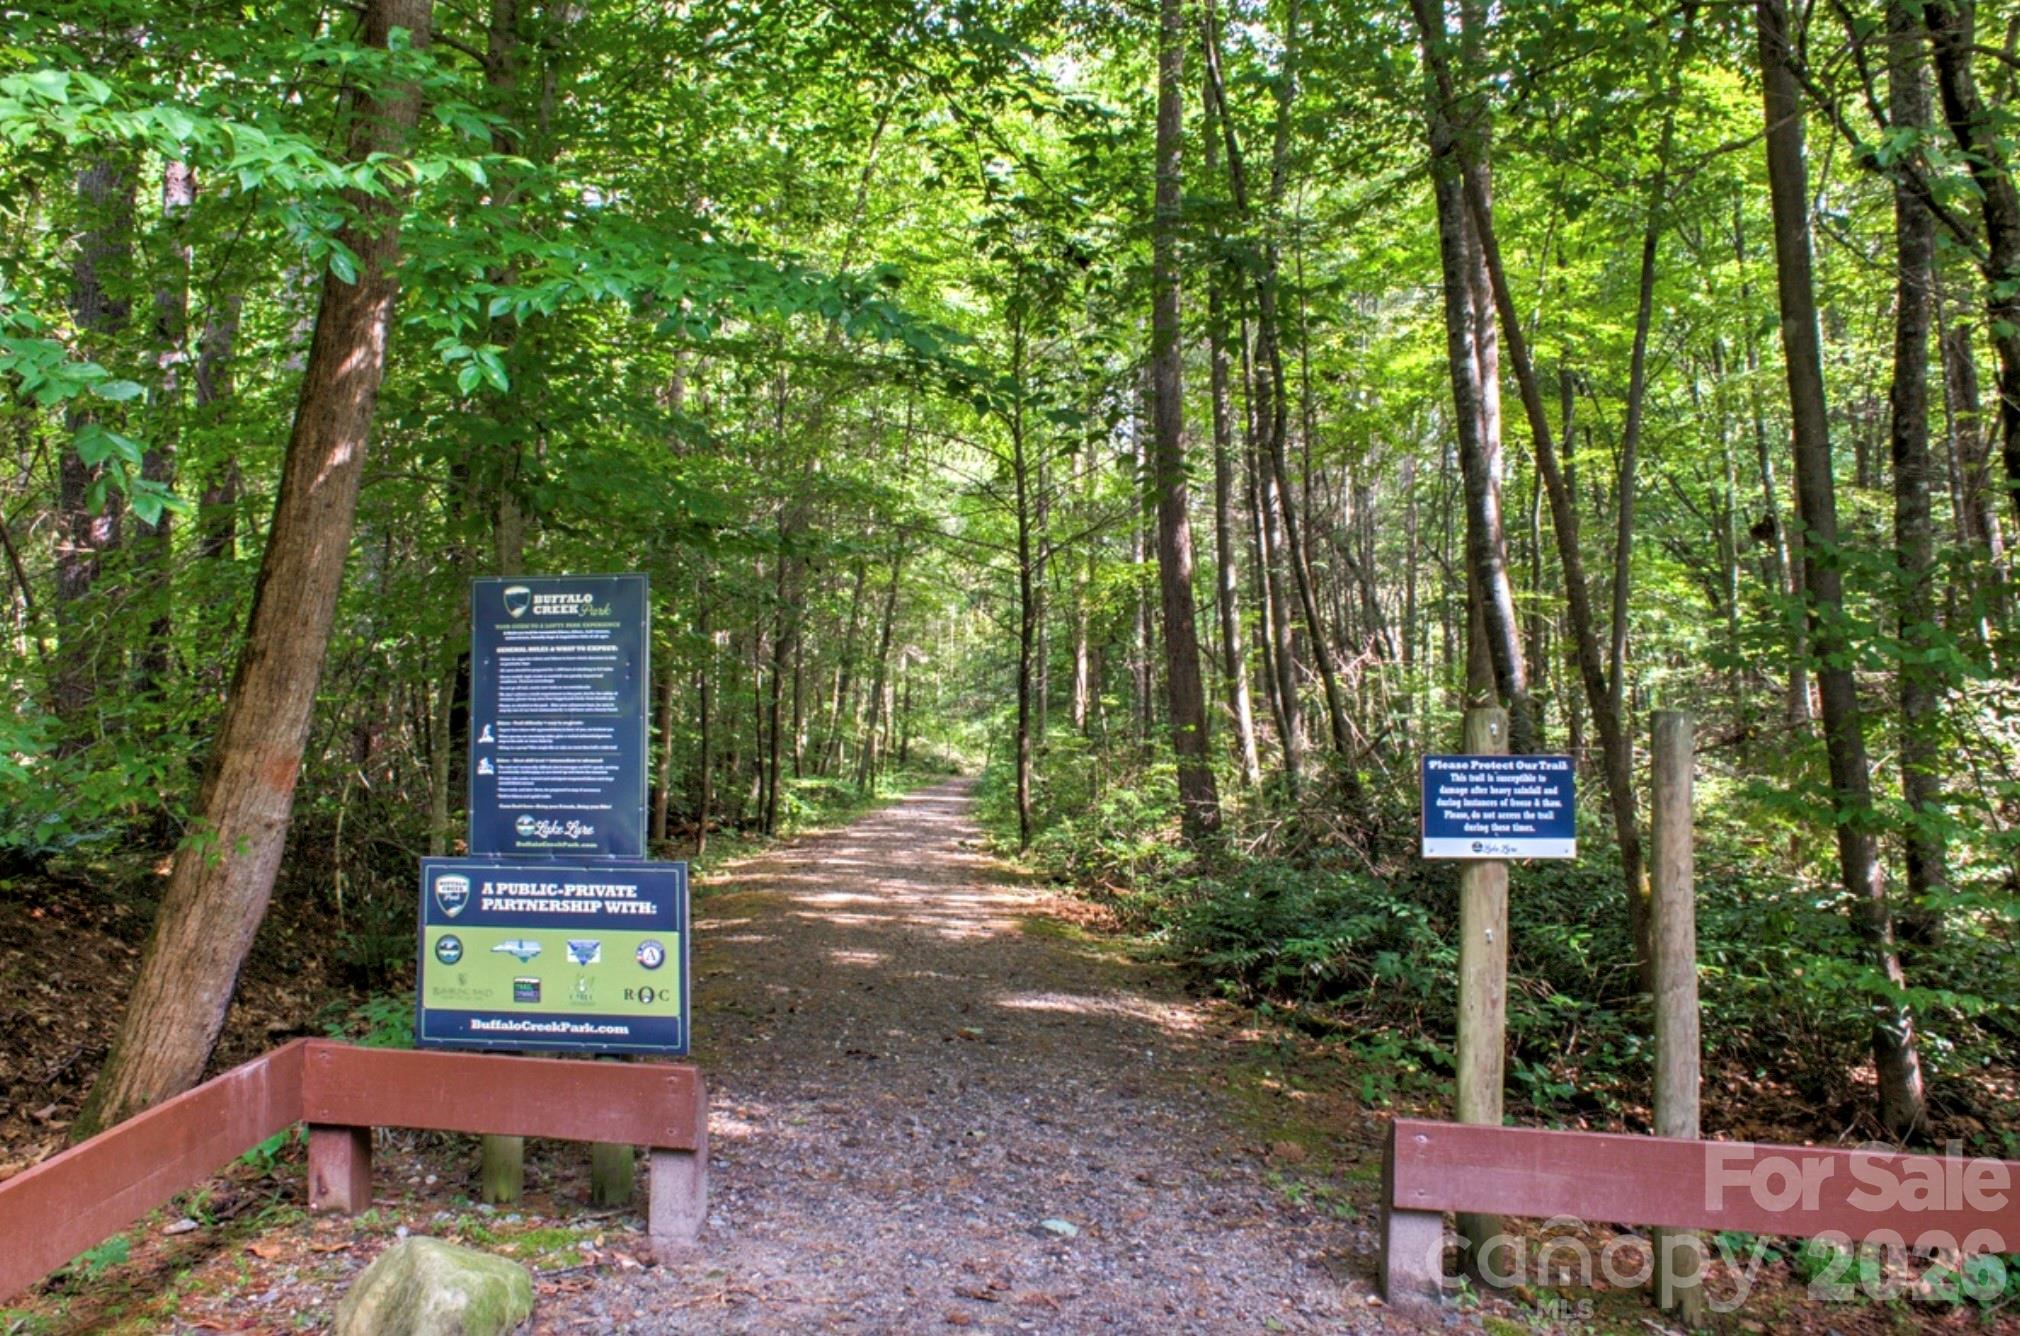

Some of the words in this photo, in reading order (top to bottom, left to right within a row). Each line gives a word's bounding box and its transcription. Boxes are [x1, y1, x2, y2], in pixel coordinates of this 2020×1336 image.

[533, 593, 593, 604] BUFFALO
[532, 604, 579, 615] CREEK
[578, 602, 612, 617] Park
[1428, 760, 1469, 770] Please
[1470, 760, 1514, 770] Protect
[1515, 760, 1538, 770] Our
[1450, 773, 1467, 783] This
[1468, 773, 1486, 783] trail
[1487, 773, 1494, 783] is
[1495, 773, 1536, 785] susceptible
[1538, 774, 1547, 783] to
[1439, 785, 1468, 797] damage
[1470, 785, 1488, 795] after
[1489, 785, 1512, 797] heavy
[1513, 785, 1542, 795] rainfall
[1543, 785, 1558, 795] and
[1436, 798, 1461, 809] during
[1463, 798, 1498, 807] instances
[1499, 798, 1508, 807] of
[1509, 798, 1532, 807] freeze
[1534, 798, 1540, 807] &
[1443, 810, 1471, 820] Please,
[1471, 810, 1481, 820] do
[1482, 810, 1496, 820] not
[1497, 811, 1521, 820] access
[1522, 810, 1535, 820] the
[1537, 810, 1555, 820] trail
[533, 819, 564, 839] Lake
[564, 819, 595, 839] Lure
[1463, 822, 1489, 834] during
[1490, 822, 1511, 832] these
[1512, 822, 1536, 832] times.
[481, 882, 494, 895] A
[496, 882, 638, 898] PUBLIC-PRIVATE
[481, 898, 603, 913] PARTNERSHIP
[604, 900, 658, 914] WITH:
[470, 1018, 629, 1035] BuffaloCreekPark.com
